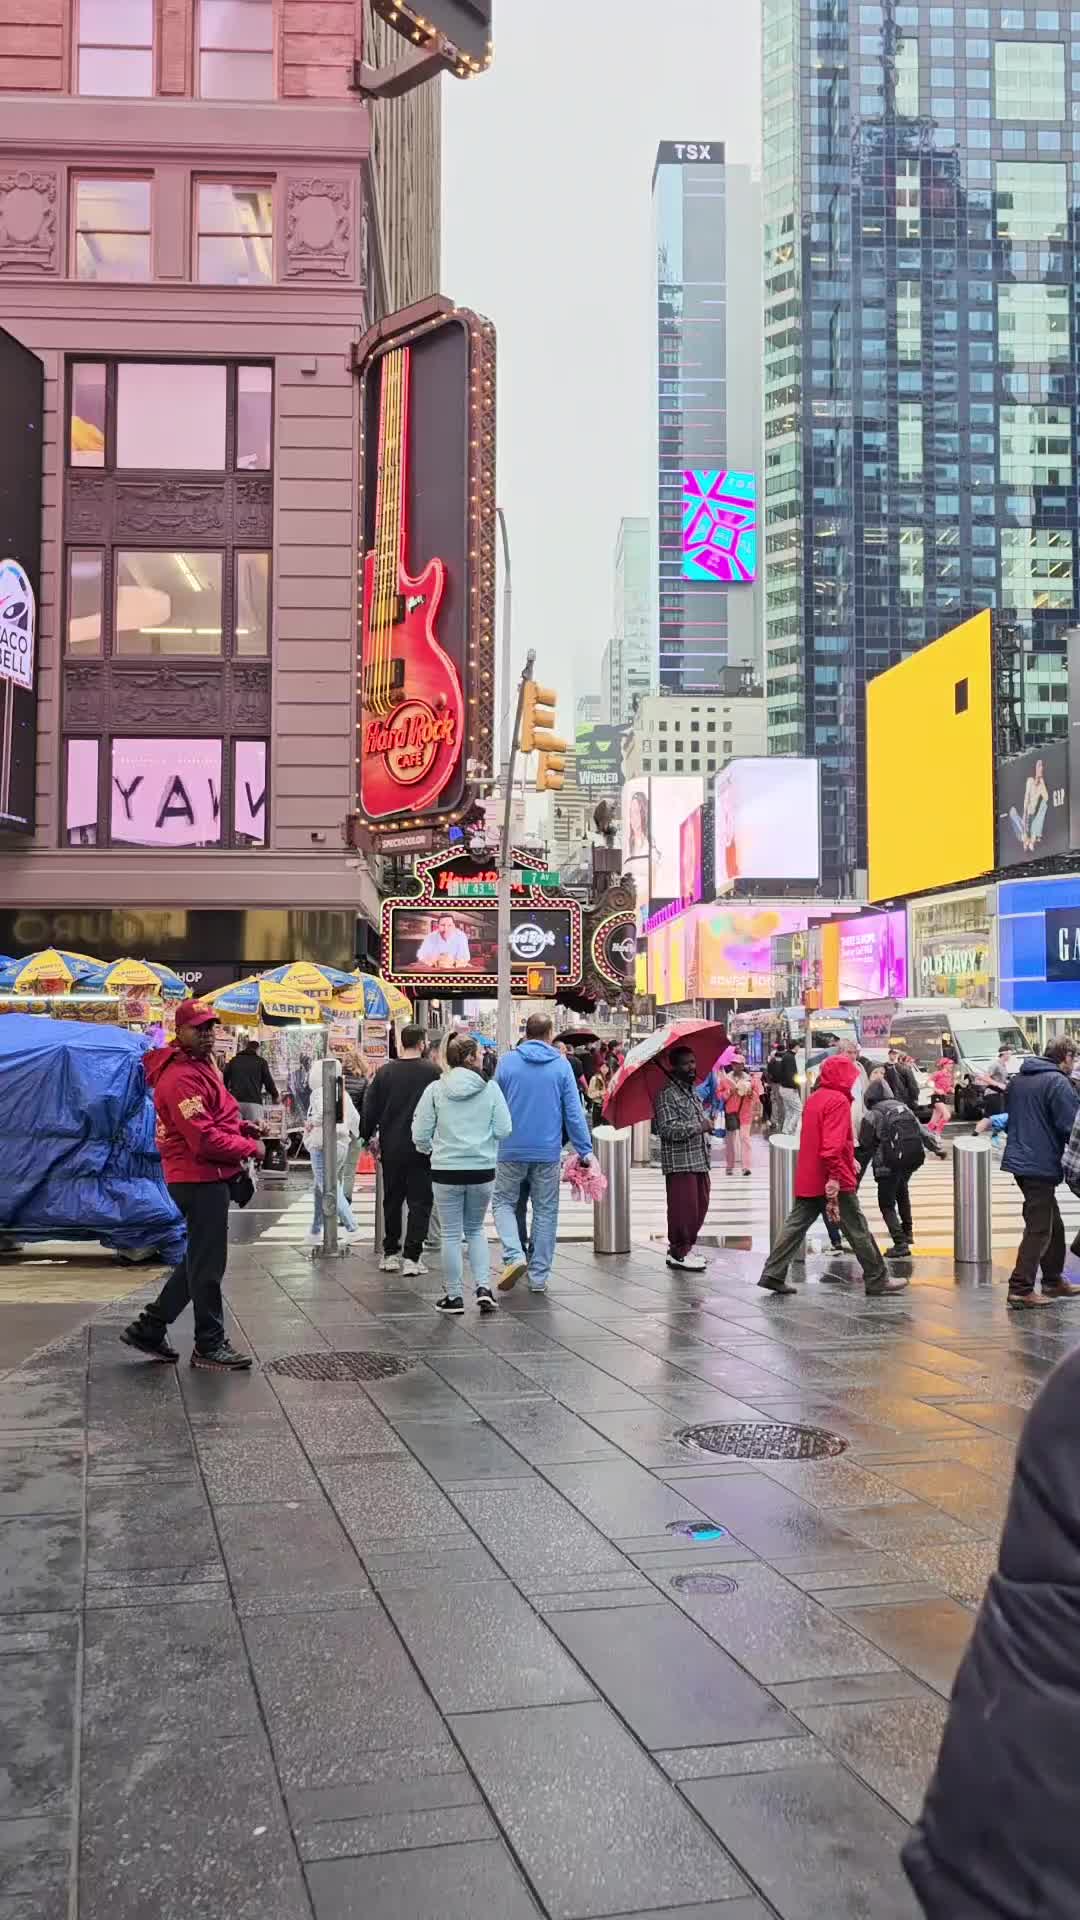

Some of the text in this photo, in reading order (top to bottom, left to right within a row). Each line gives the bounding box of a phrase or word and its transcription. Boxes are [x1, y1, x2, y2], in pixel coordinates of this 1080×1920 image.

[674, 143, 711, 160] TSX
[0, 627, 28, 654] ACO
[364, 709, 455, 754] Hard Rock
[396, 752, 423, 768] CAFE
[1052, 788, 1065, 807] GAP
[531, 872, 538, 884] 7
[473, 882, 486, 895] 43
[921, 949, 977, 976] OLD NAVY
[176, 971, 203, 984] HOP
